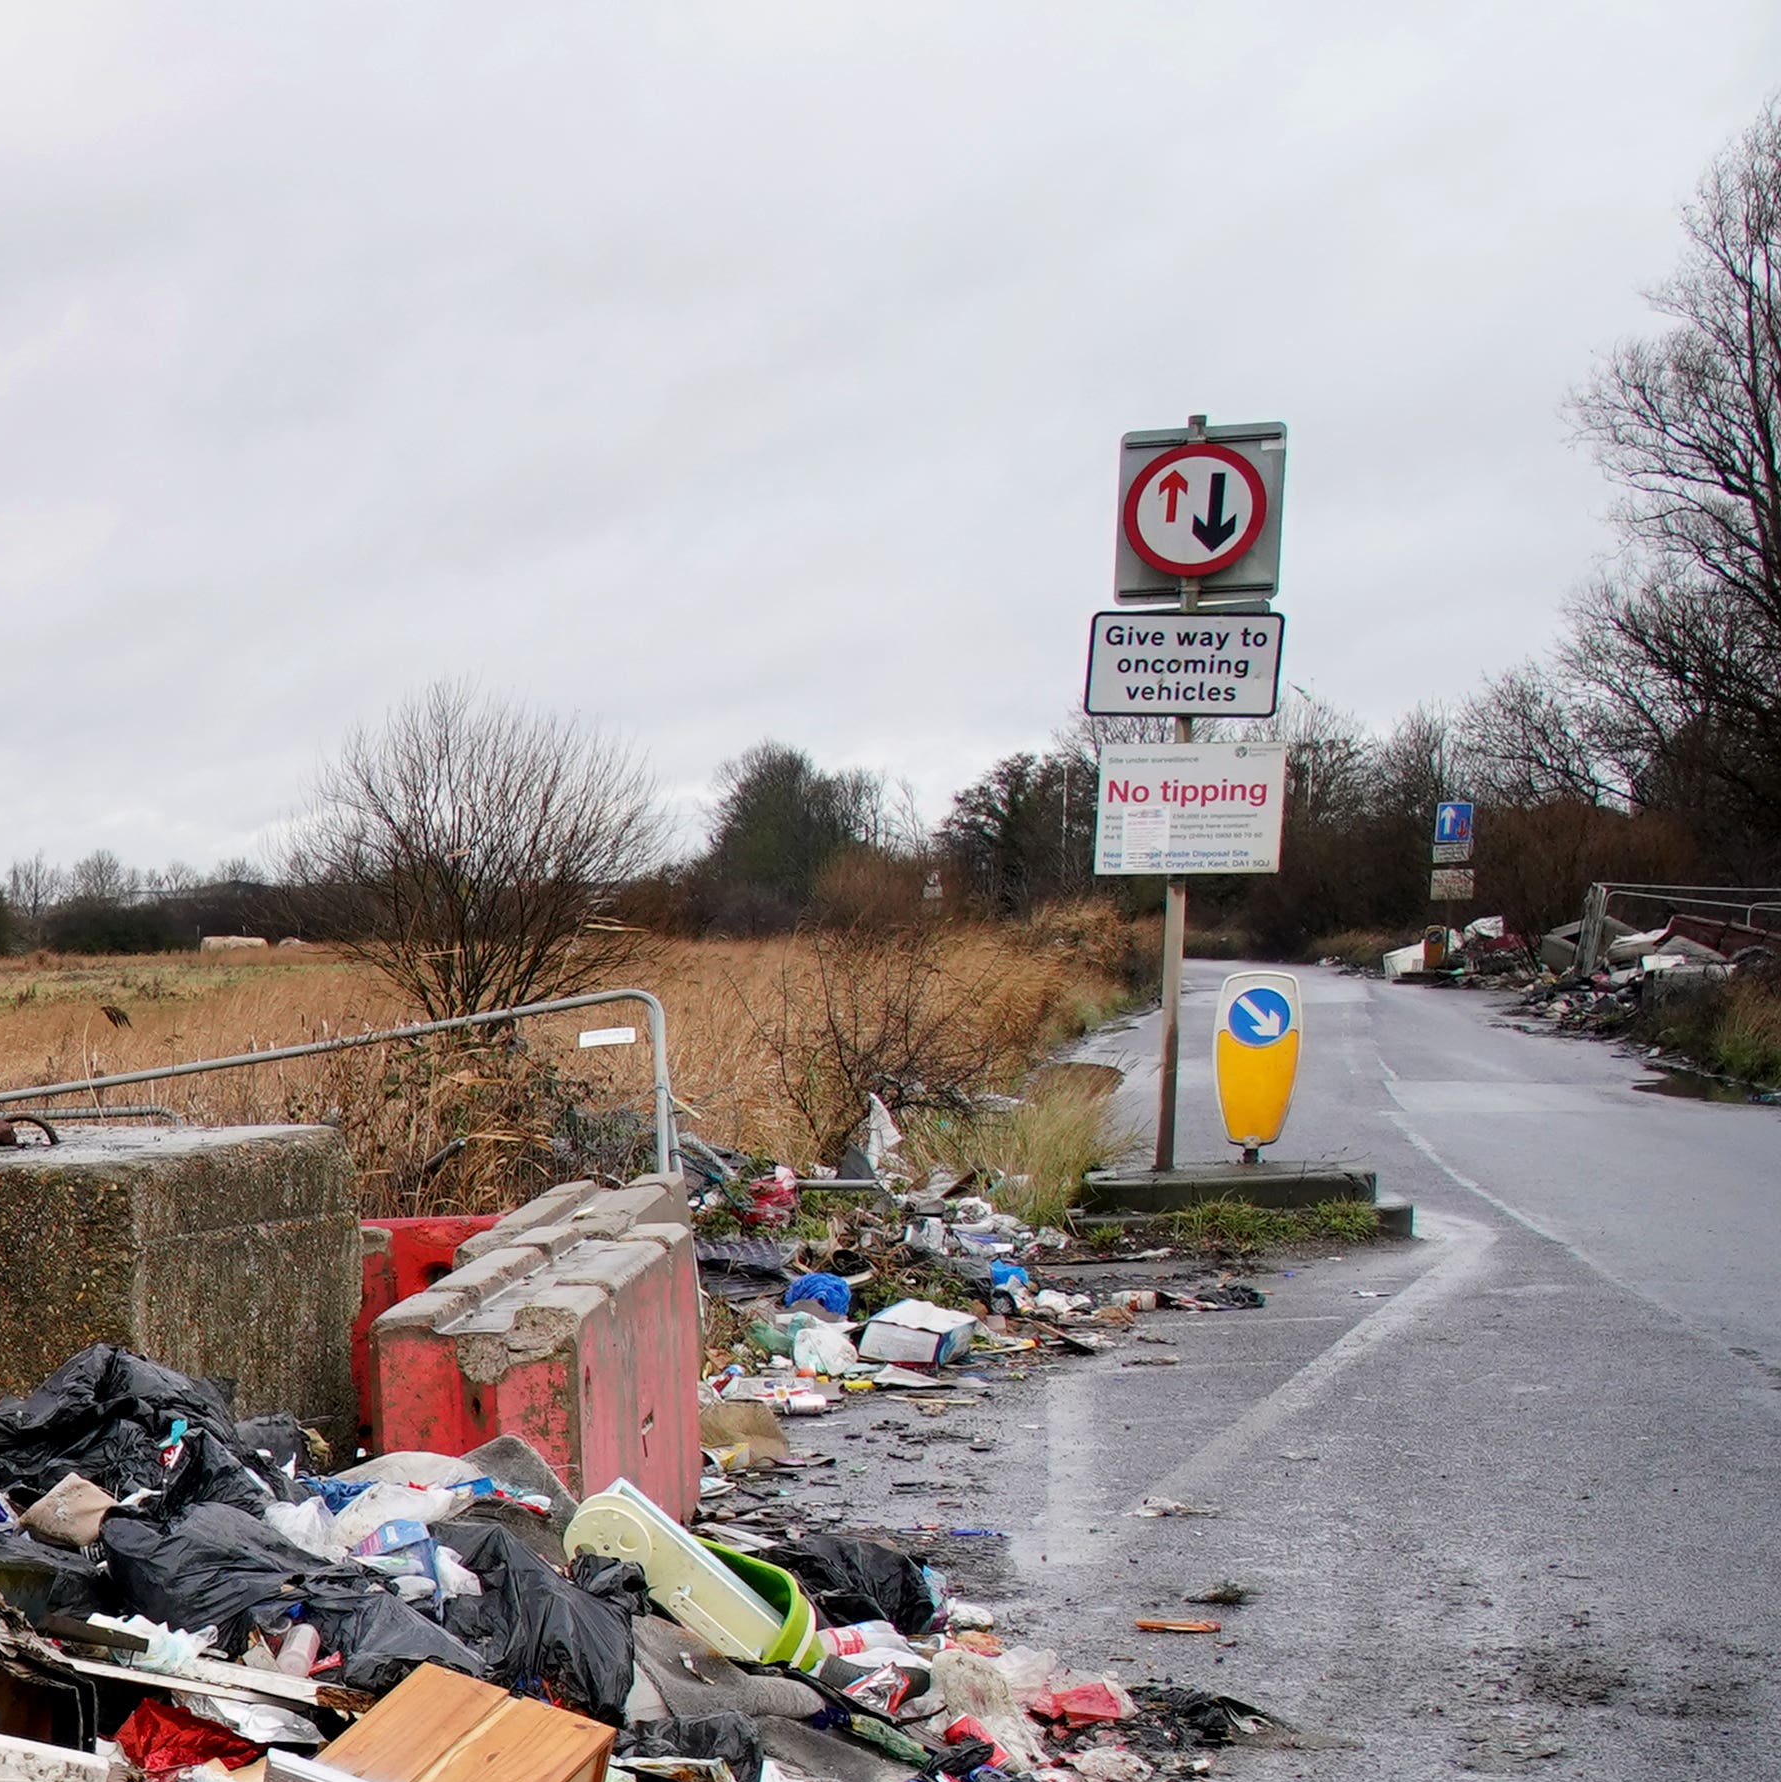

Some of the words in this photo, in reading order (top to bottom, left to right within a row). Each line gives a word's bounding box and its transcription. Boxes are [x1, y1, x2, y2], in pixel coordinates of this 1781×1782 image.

[1105, 625, 1165, 647] Give
[1177, 629, 1231, 650] way
[1241, 627, 1268, 647] to
[1117, 655, 1250, 678] oncoming
[1126, 682, 1236, 703] vehicles
[1151, 756, 1199, 764] surveillance
[1107, 780, 1149, 803] No
[1160, 778, 1267, 807] tipping
[1192, 850, 1230, 859] Disposal
